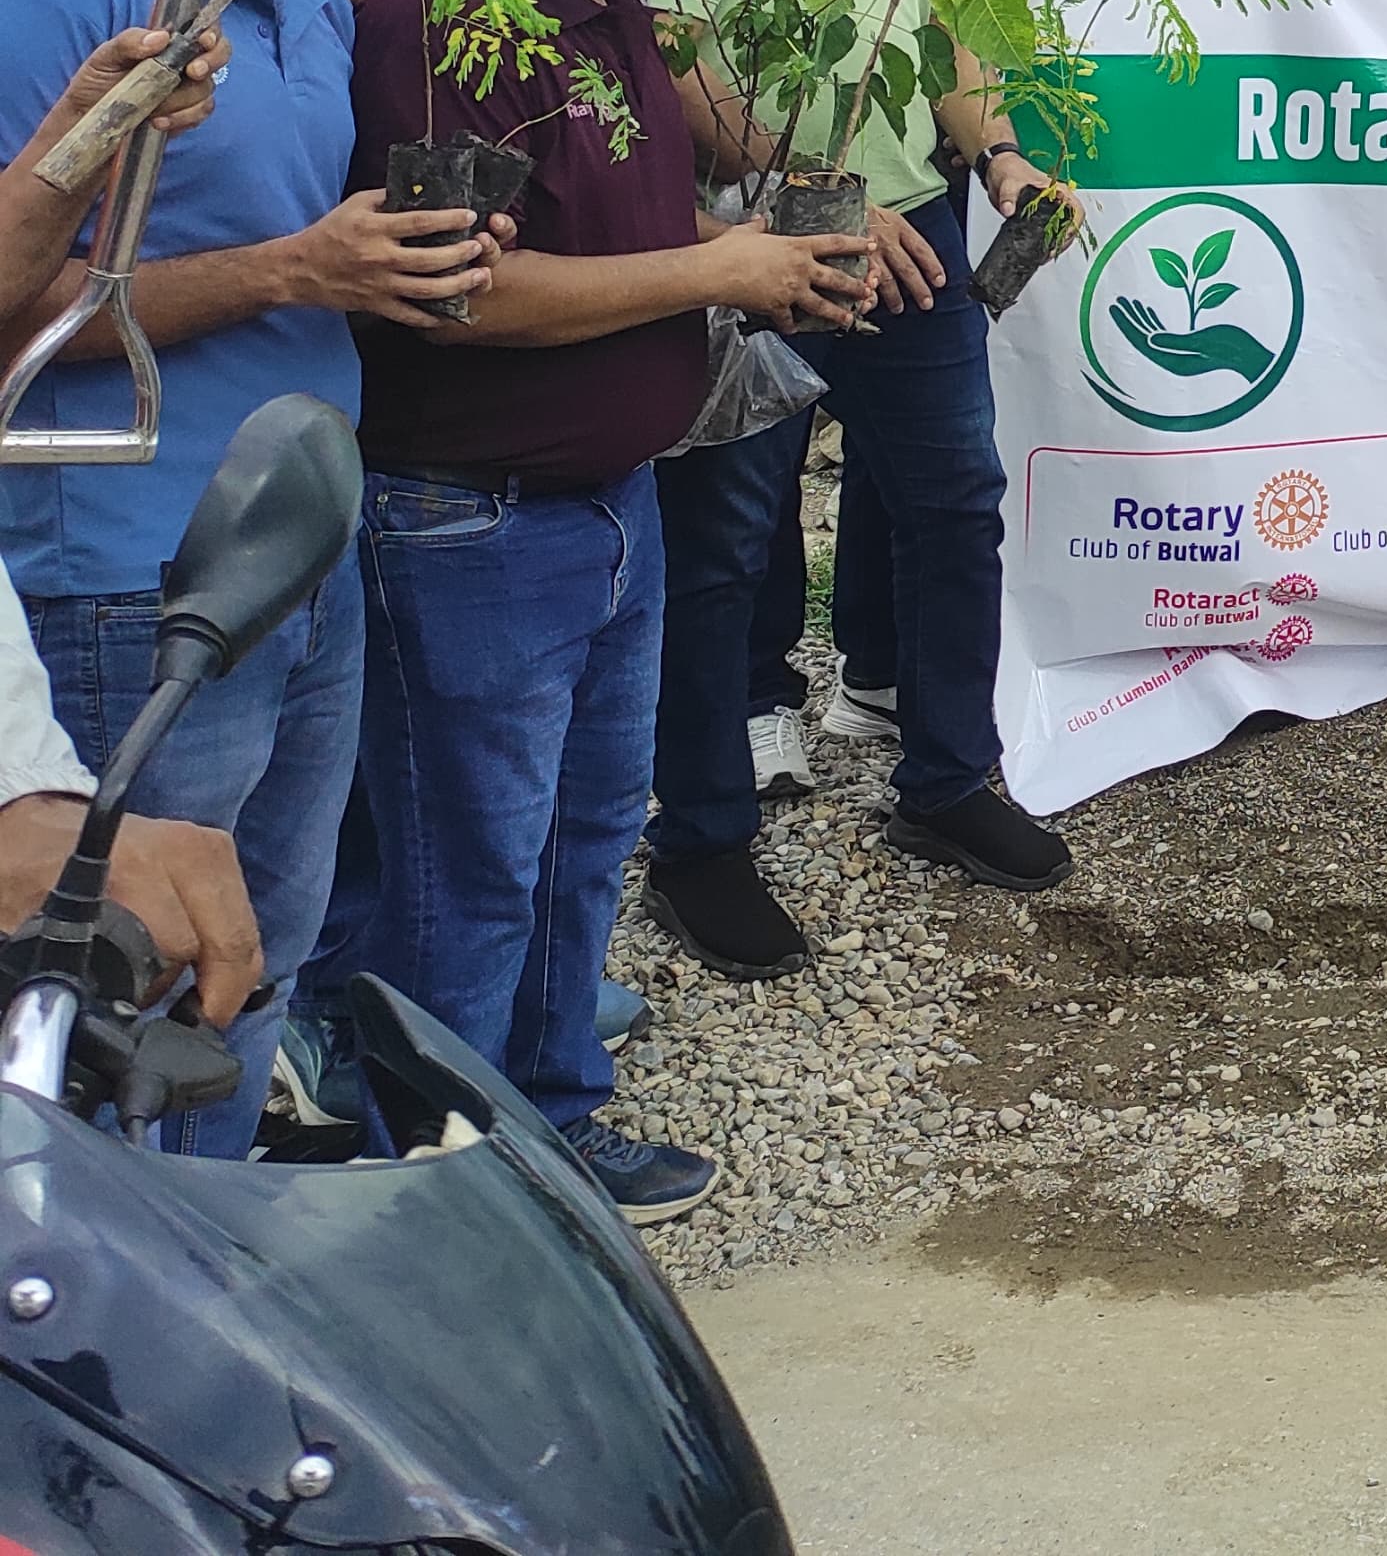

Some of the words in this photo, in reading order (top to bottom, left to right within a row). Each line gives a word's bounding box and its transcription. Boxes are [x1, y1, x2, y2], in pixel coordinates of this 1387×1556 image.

[1113, 498, 1244, 537] Rotary
[1070, 538, 1118, 558] Club
[1127, 540, 1151, 560] of
[1157, 539, 1240, 562] Butwal
[1333, 530, 1370, 552] Club
[1153, 587, 1260, 609] Rotaract
[1145, 613, 1177, 628] Club
[1184, 612, 1201, 626] of
[1204, 605, 1259, 625] Butwal
[1067, 709, 1098, 733] Club
[1100, 698, 1114, 716] of
[1115, 669, 1172, 708] Lumbini
